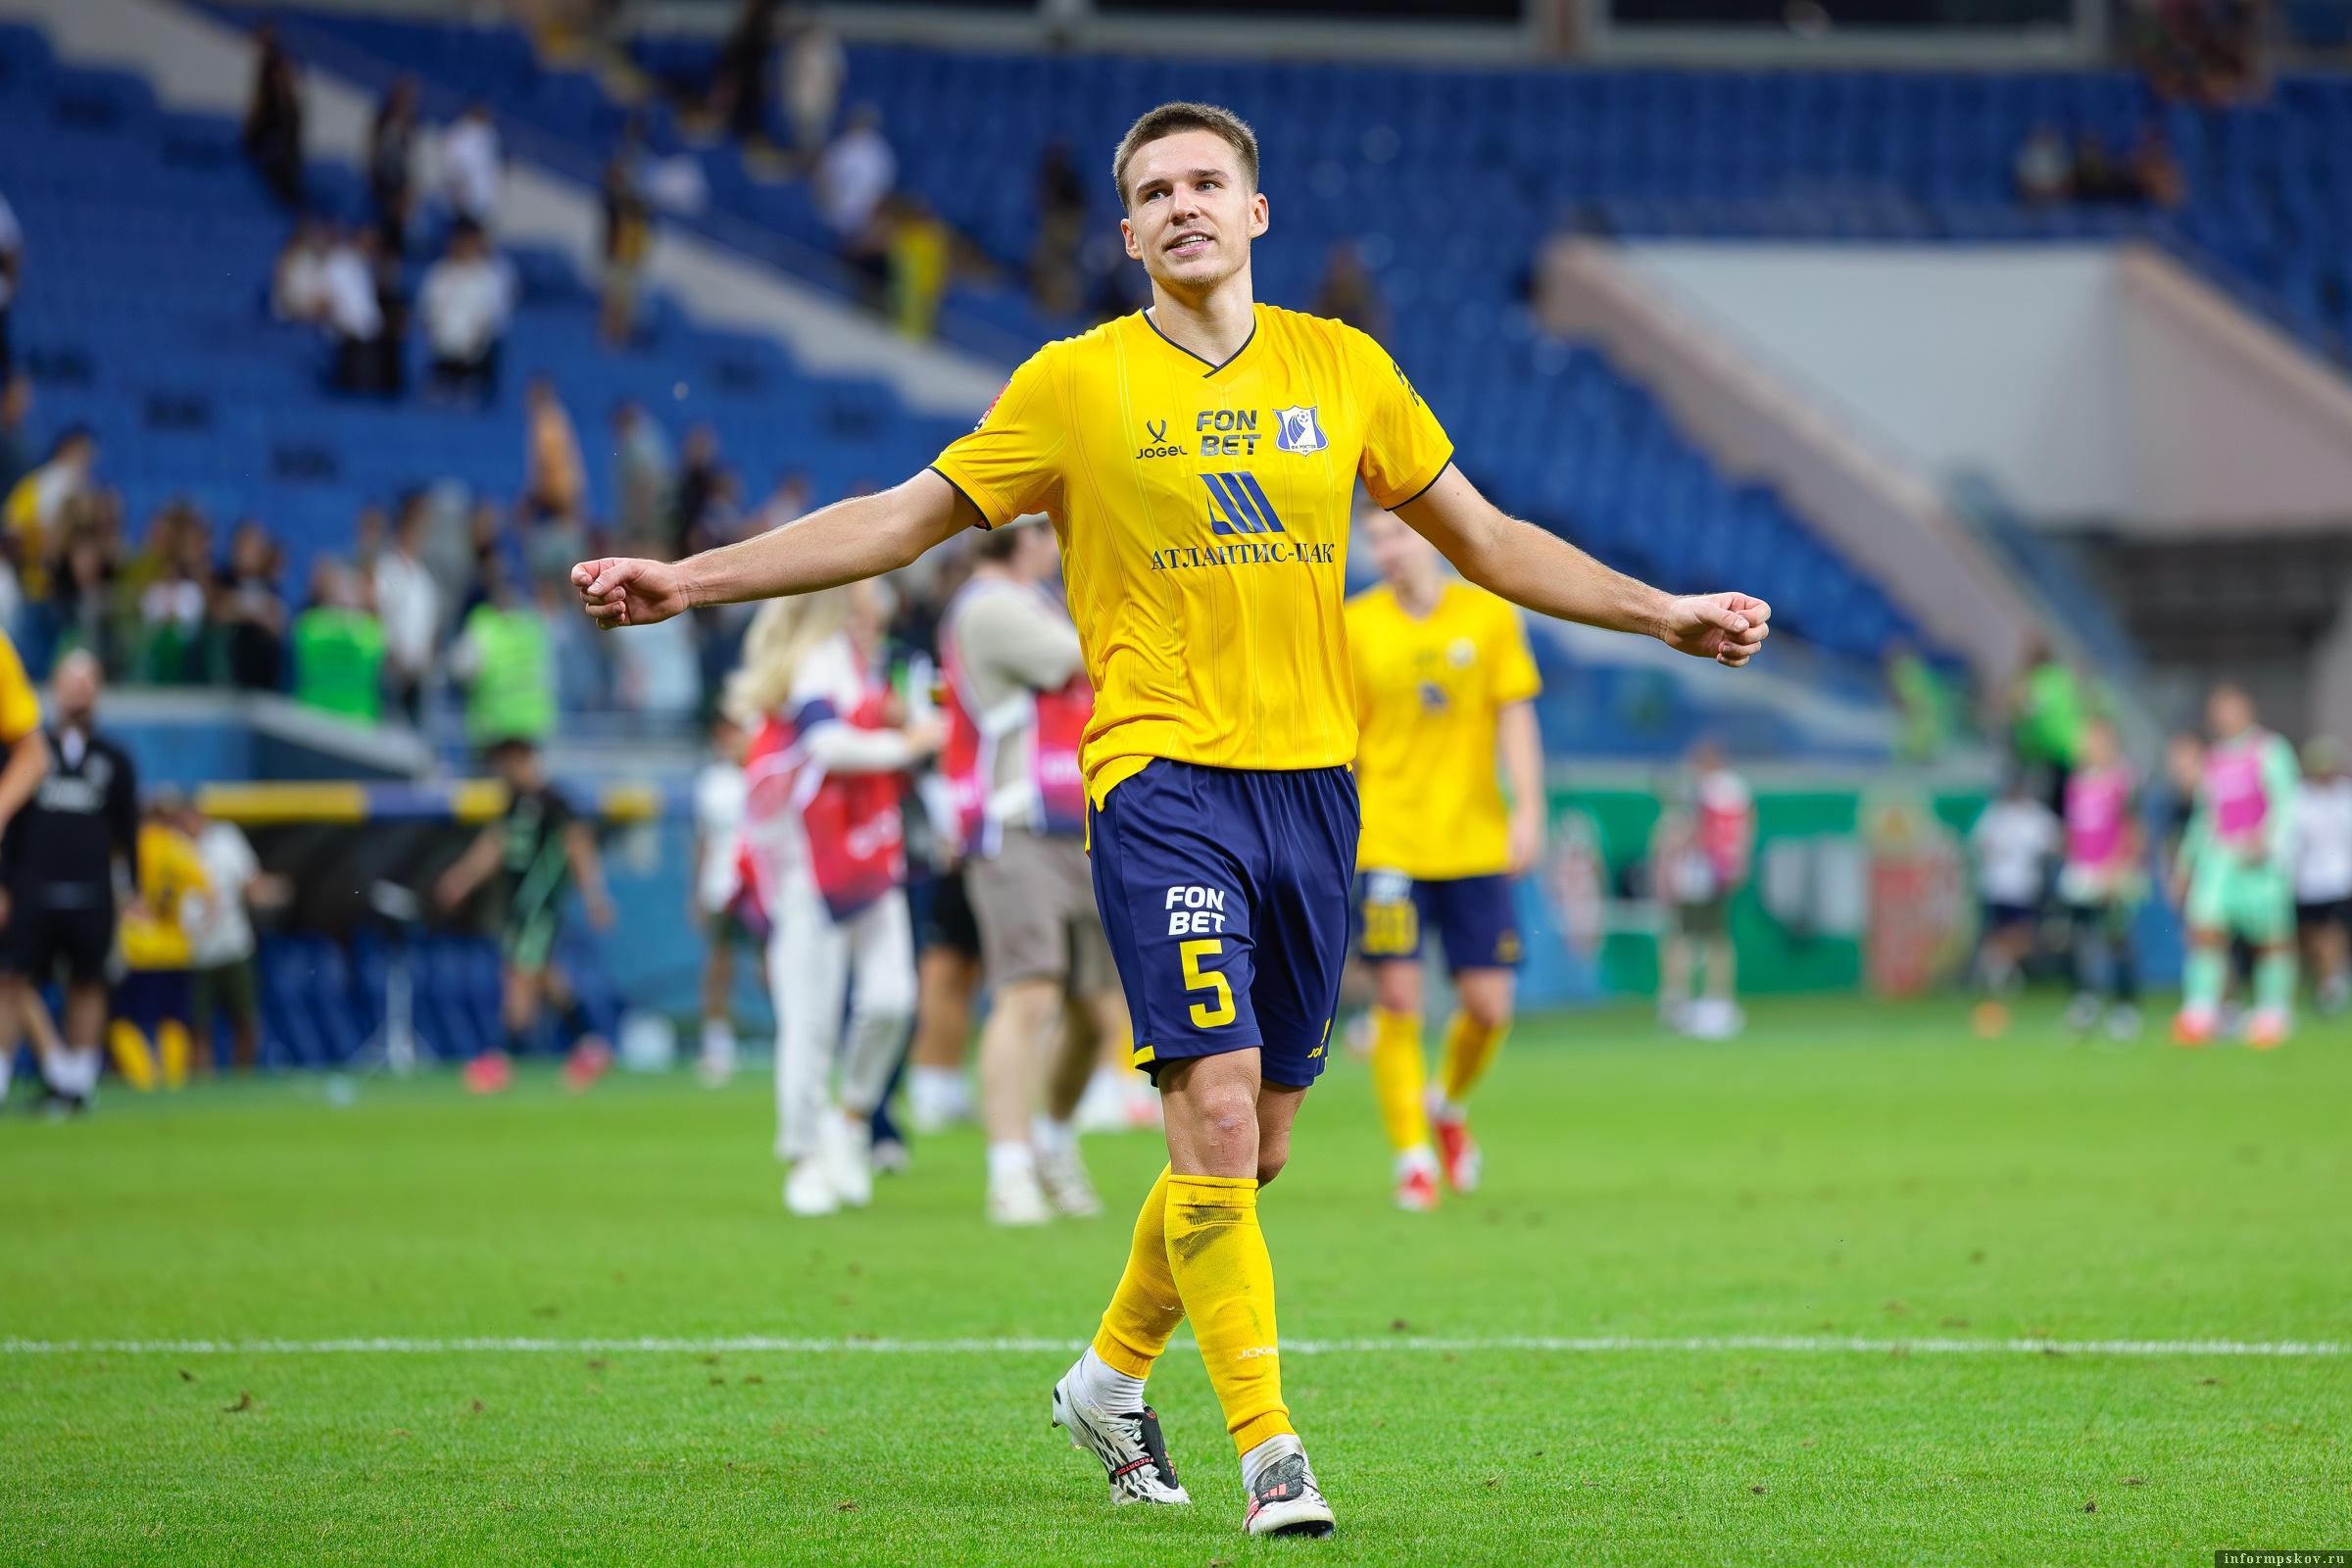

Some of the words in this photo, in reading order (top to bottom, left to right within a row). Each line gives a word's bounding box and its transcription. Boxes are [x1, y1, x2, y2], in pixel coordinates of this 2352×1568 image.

[1197, 410, 1257, 432] FON
[1200, 434, 1262, 458] BET
[1152, 542, 1336, 570] АТЛАНТИС-ПАК
[1165, 886, 1225, 911] FON
[1168, 910, 1226, 936] BET
[1179, 939, 1237, 1029] 5
